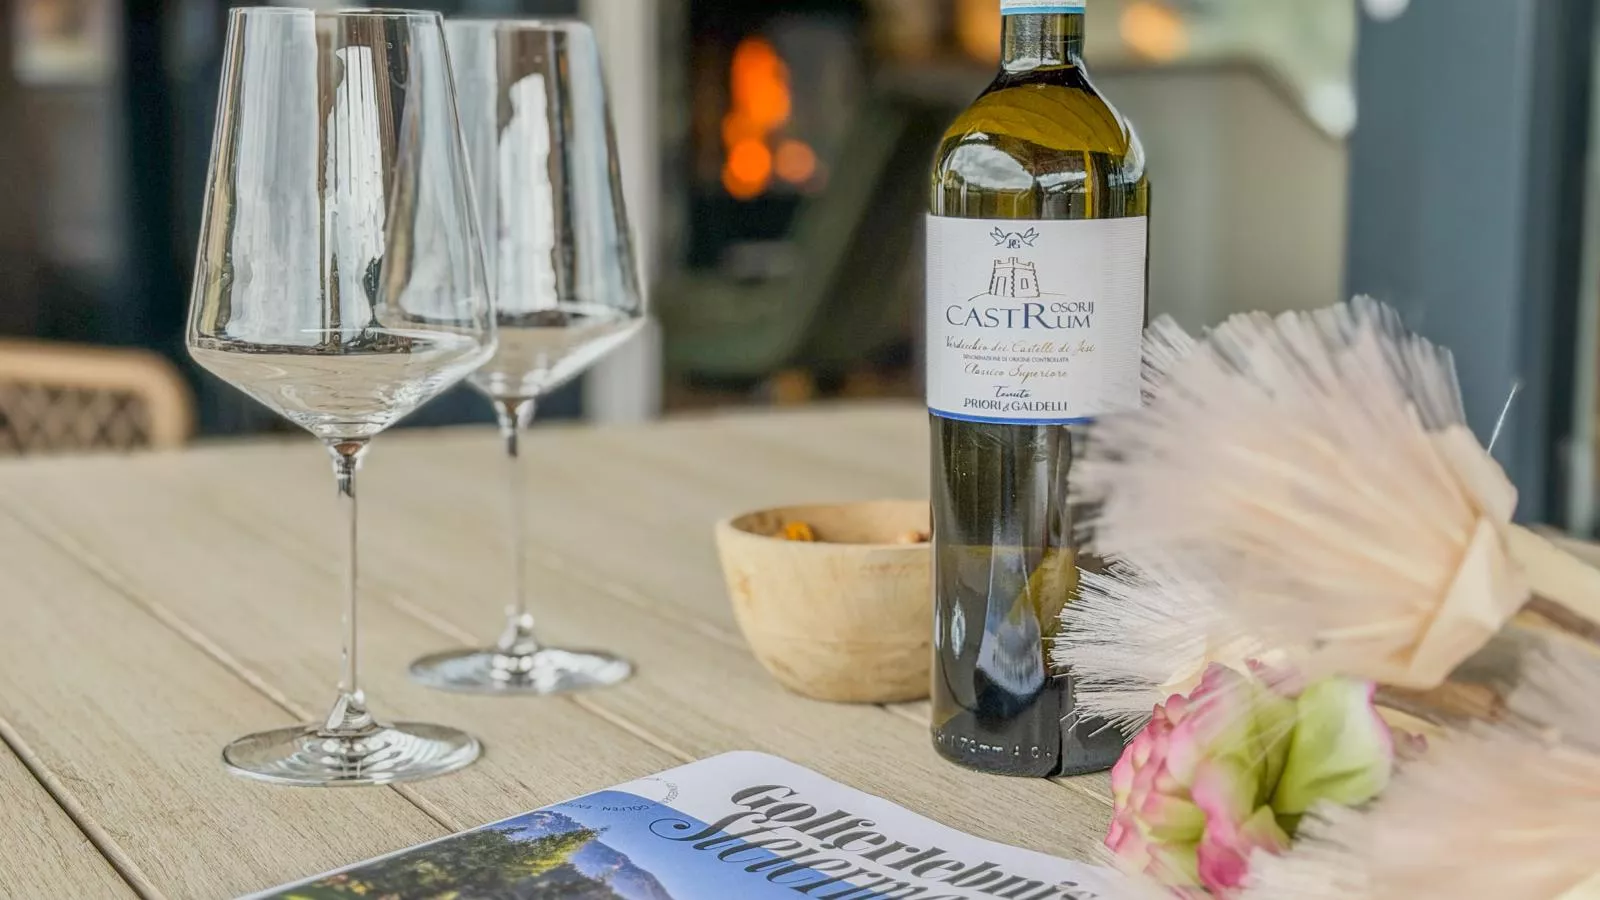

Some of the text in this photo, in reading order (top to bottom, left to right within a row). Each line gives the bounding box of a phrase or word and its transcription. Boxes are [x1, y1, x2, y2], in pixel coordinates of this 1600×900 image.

[1050, 301, 1095, 314] OSORIJ
[964, 362, 1068, 384] Classico Superiore
[963, 398, 1001, 411] PRIORI
[1011, 401, 1068, 412] GALDELLI
